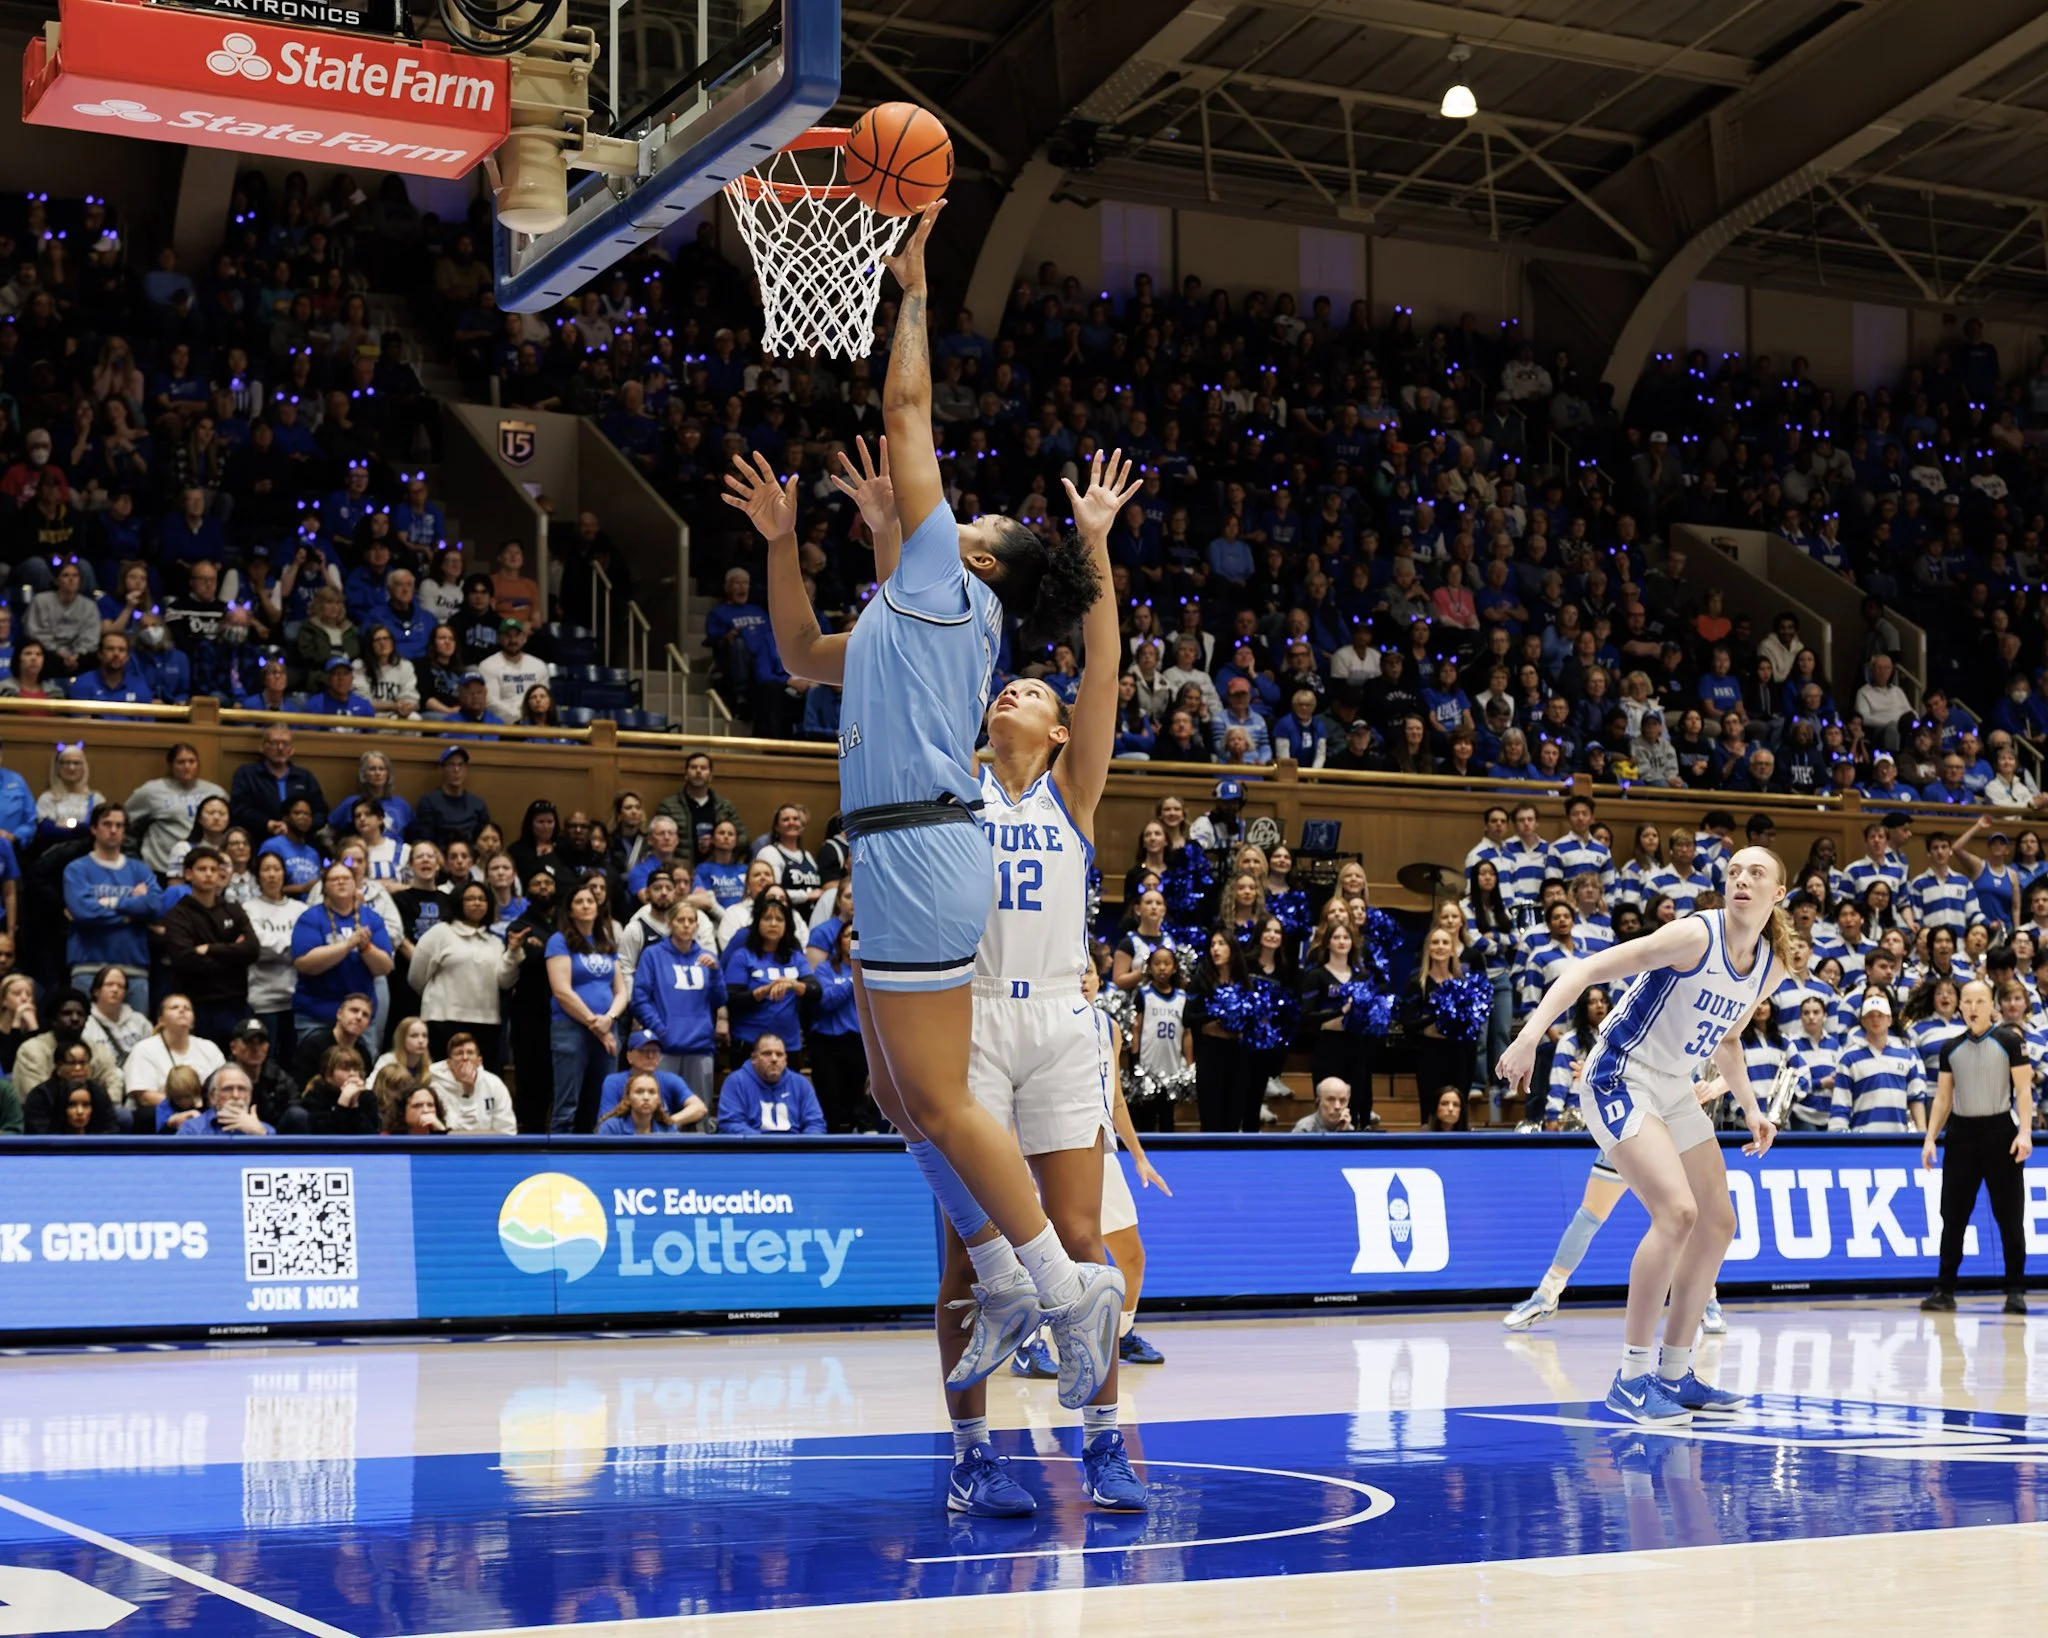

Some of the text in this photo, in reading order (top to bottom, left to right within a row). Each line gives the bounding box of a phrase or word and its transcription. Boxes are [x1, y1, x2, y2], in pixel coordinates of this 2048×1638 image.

[506, 432, 531, 457] 15
[998, 859, 1043, 911] 12
[1011, 981, 1029, 999] D
[1157, 1021, 1175, 1040] 26
[1684, 1020, 1727, 1058] 35
[1604, 1100, 1625, 1125] D
[613, 1188, 794, 1216] NC Education
[1341, 1168, 1449, 1274] D
[0, 1221, 209, 1263] K GROUPS
[246, 1285, 360, 1311] JOIN NOW
[727, 1312, 780, 1320] DAKTRONICS
[208, 1325, 269, 1335] DAKTRONICS
